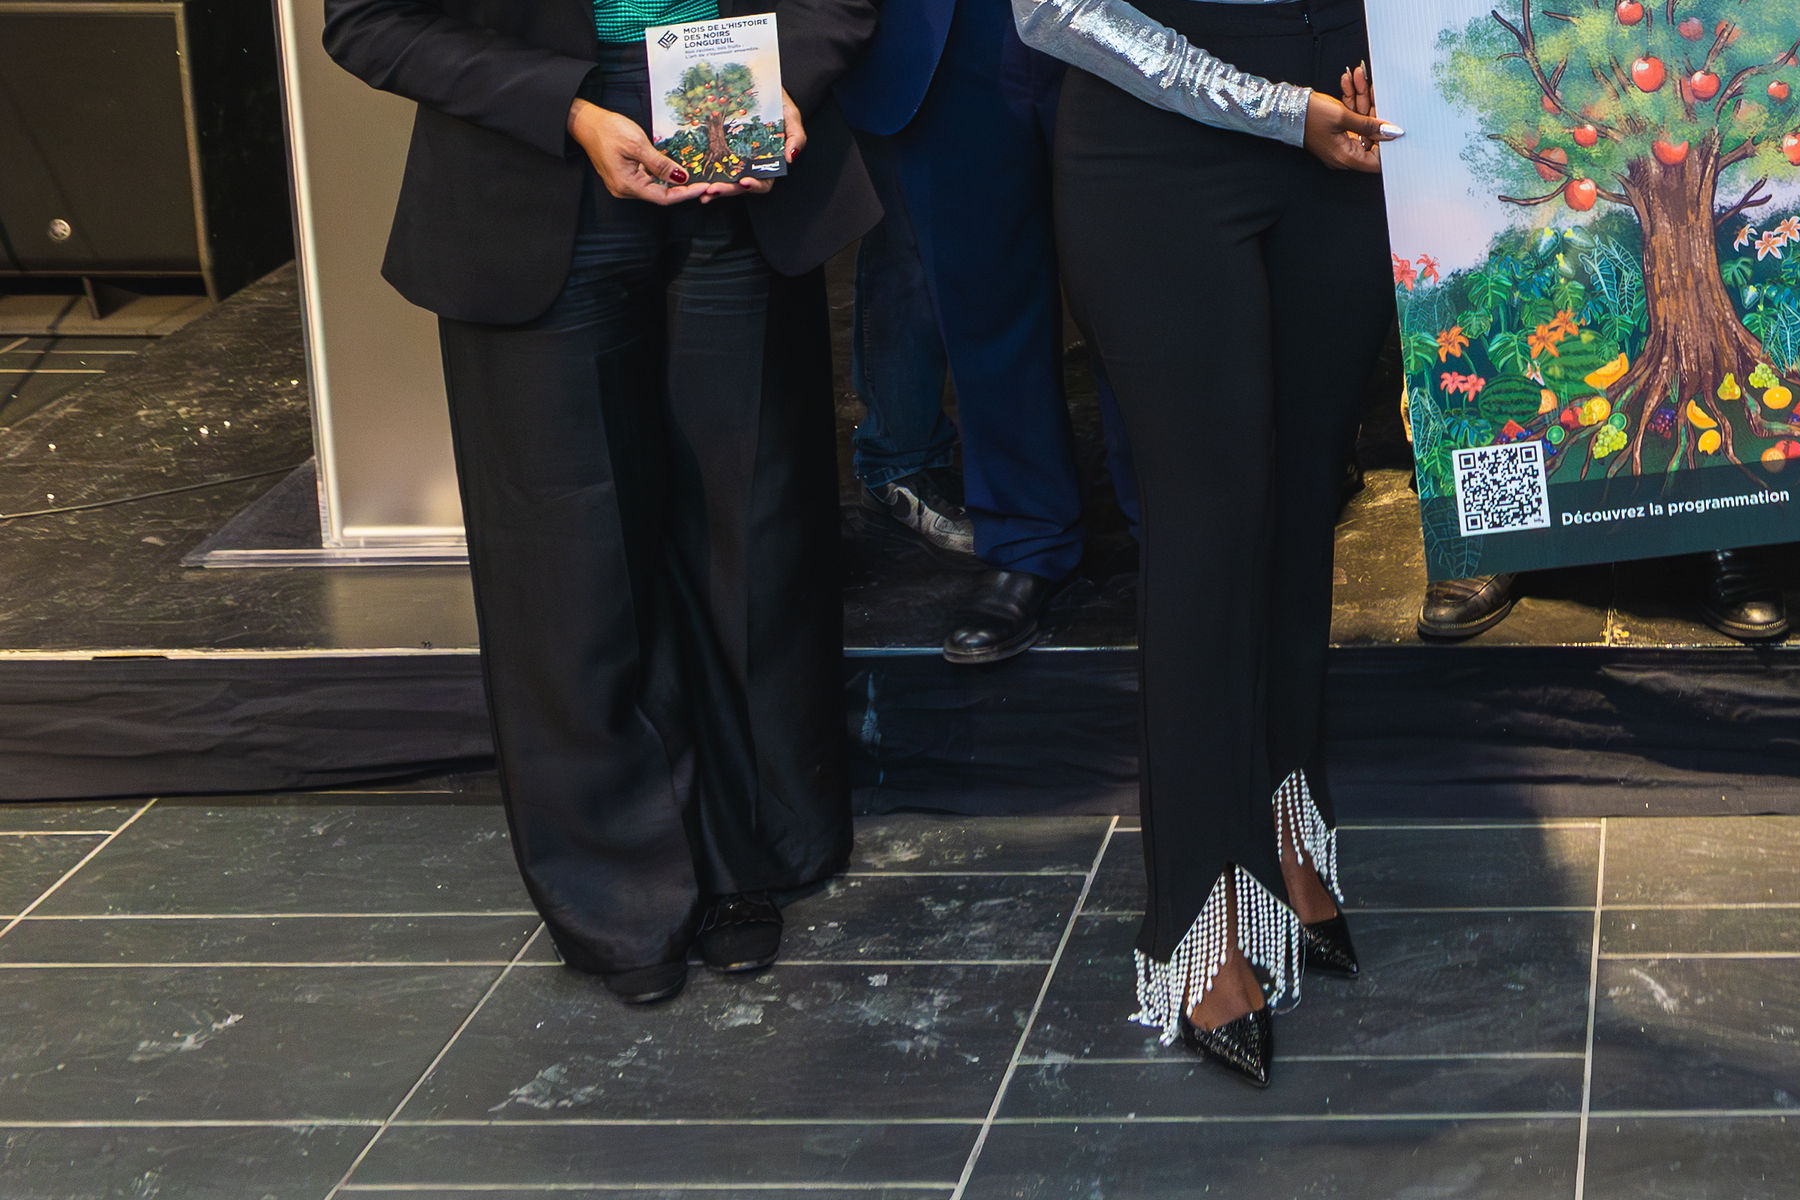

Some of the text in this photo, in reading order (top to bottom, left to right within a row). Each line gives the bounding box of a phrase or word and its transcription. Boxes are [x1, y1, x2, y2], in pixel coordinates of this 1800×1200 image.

[683, 24, 705, 34] MOIS
[684, 33, 701, 41] DES
[703, 30, 731, 39] NOIRS
[684, 37, 734, 49] LONGUEUIL
[1561, 489, 1790, 526] Découvrez la programmation
